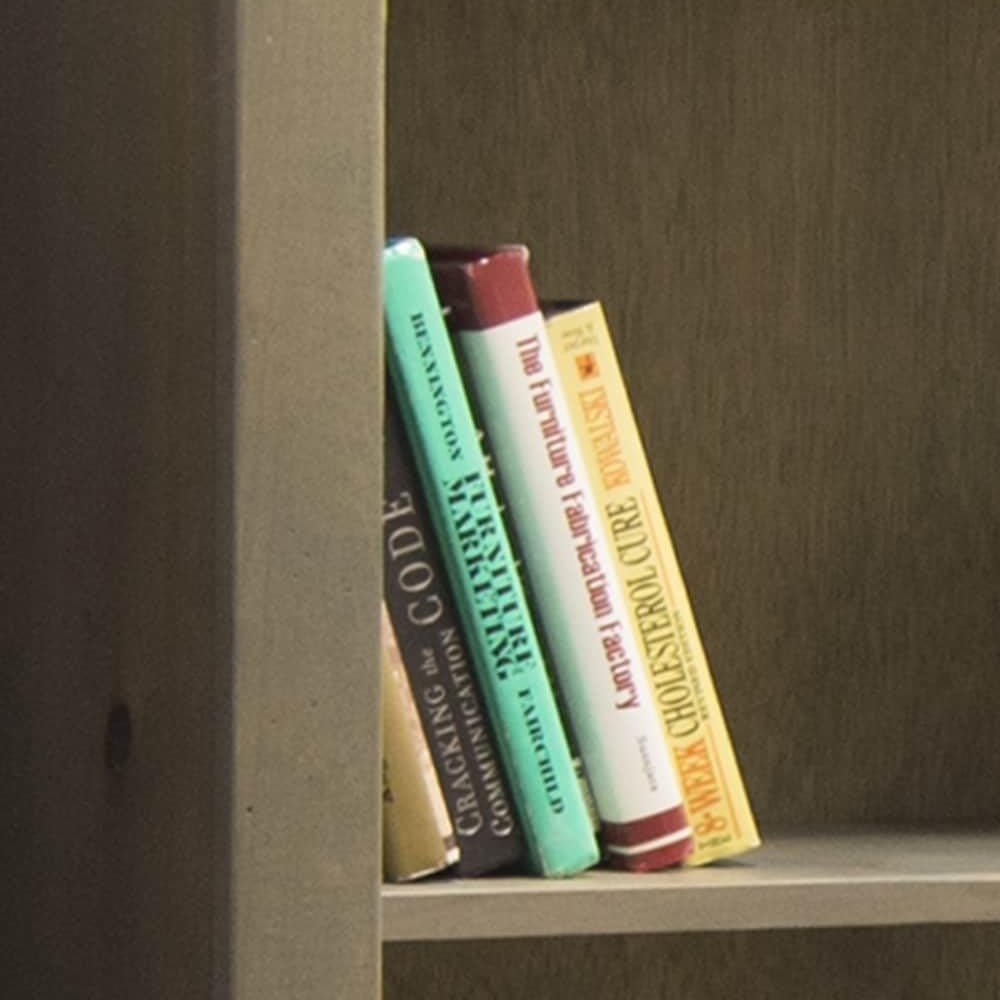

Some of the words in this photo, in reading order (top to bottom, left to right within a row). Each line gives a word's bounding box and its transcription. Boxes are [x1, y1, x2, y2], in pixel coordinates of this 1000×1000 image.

[410, 311, 465, 462] BENNINGTON
[516, 335, 544, 377] The
[529, 377, 577, 489] Furniture
[579, 386, 631, 491] KOWALSKI
[383, 491, 444, 626] CODE
[441, 476, 513, 680] MARKETING
[464, 471, 537, 674] FURNITURE
[561, 489, 614, 619] Fabrication
[604, 495, 652, 567] CURE
[420, 647, 440, 677] the
[597, 620, 641, 712] Factory
[627, 576, 700, 739] CHOLESTEROL
[424, 683, 484, 837] CRACKING
[440, 627, 515, 837] COMMUNICATION
[518, 687, 565, 815] FAIRCHILD
[673, 738, 727, 836] 8-WEEK
